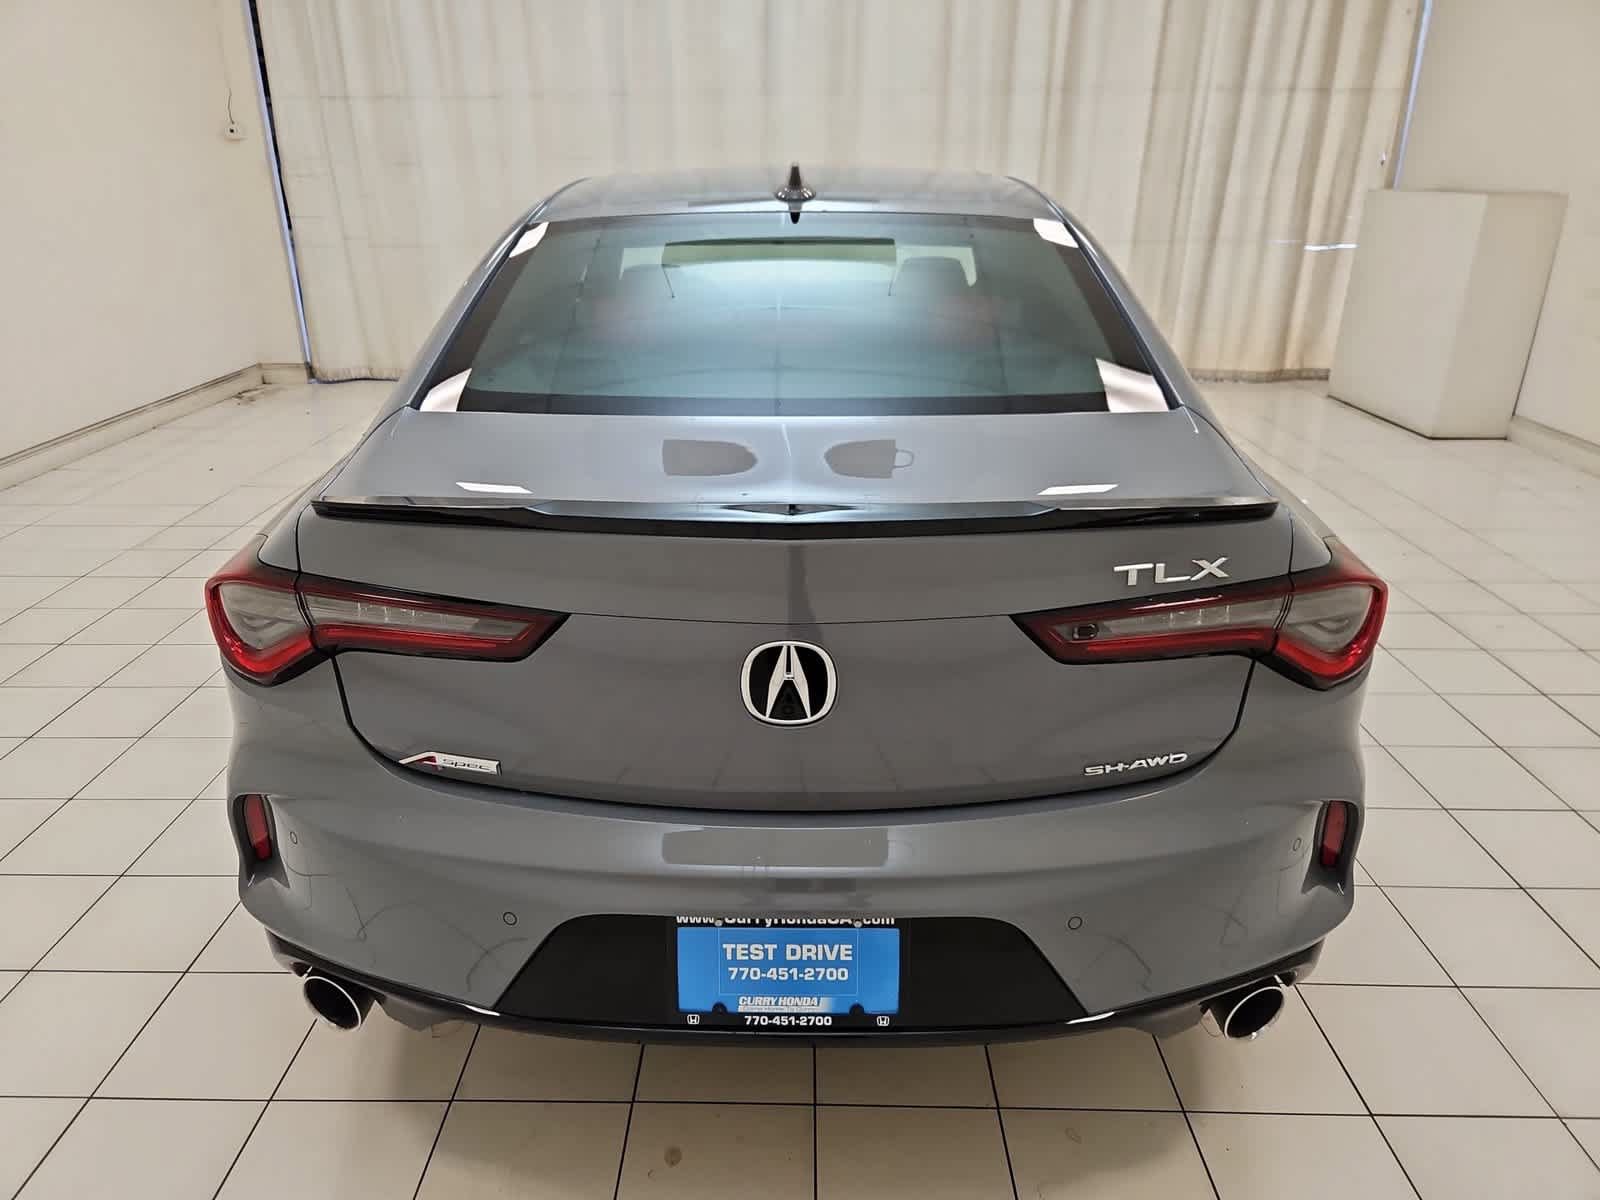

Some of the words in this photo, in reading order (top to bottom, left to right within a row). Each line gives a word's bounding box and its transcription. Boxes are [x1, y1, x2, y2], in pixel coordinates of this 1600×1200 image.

[1113, 557, 1229, 586] TLX
[1084, 753, 1188, 776] SH-AWD
[722, 943, 778, 961] TEST
[785, 944, 853, 961] DRIVE
[728, 967, 849, 981] 770-451-2700
[739, 996, 778, 1006] CURRY
[778, 996, 818, 1006] HONDA
[744, 1015, 833, 1026] 770-451-2700
